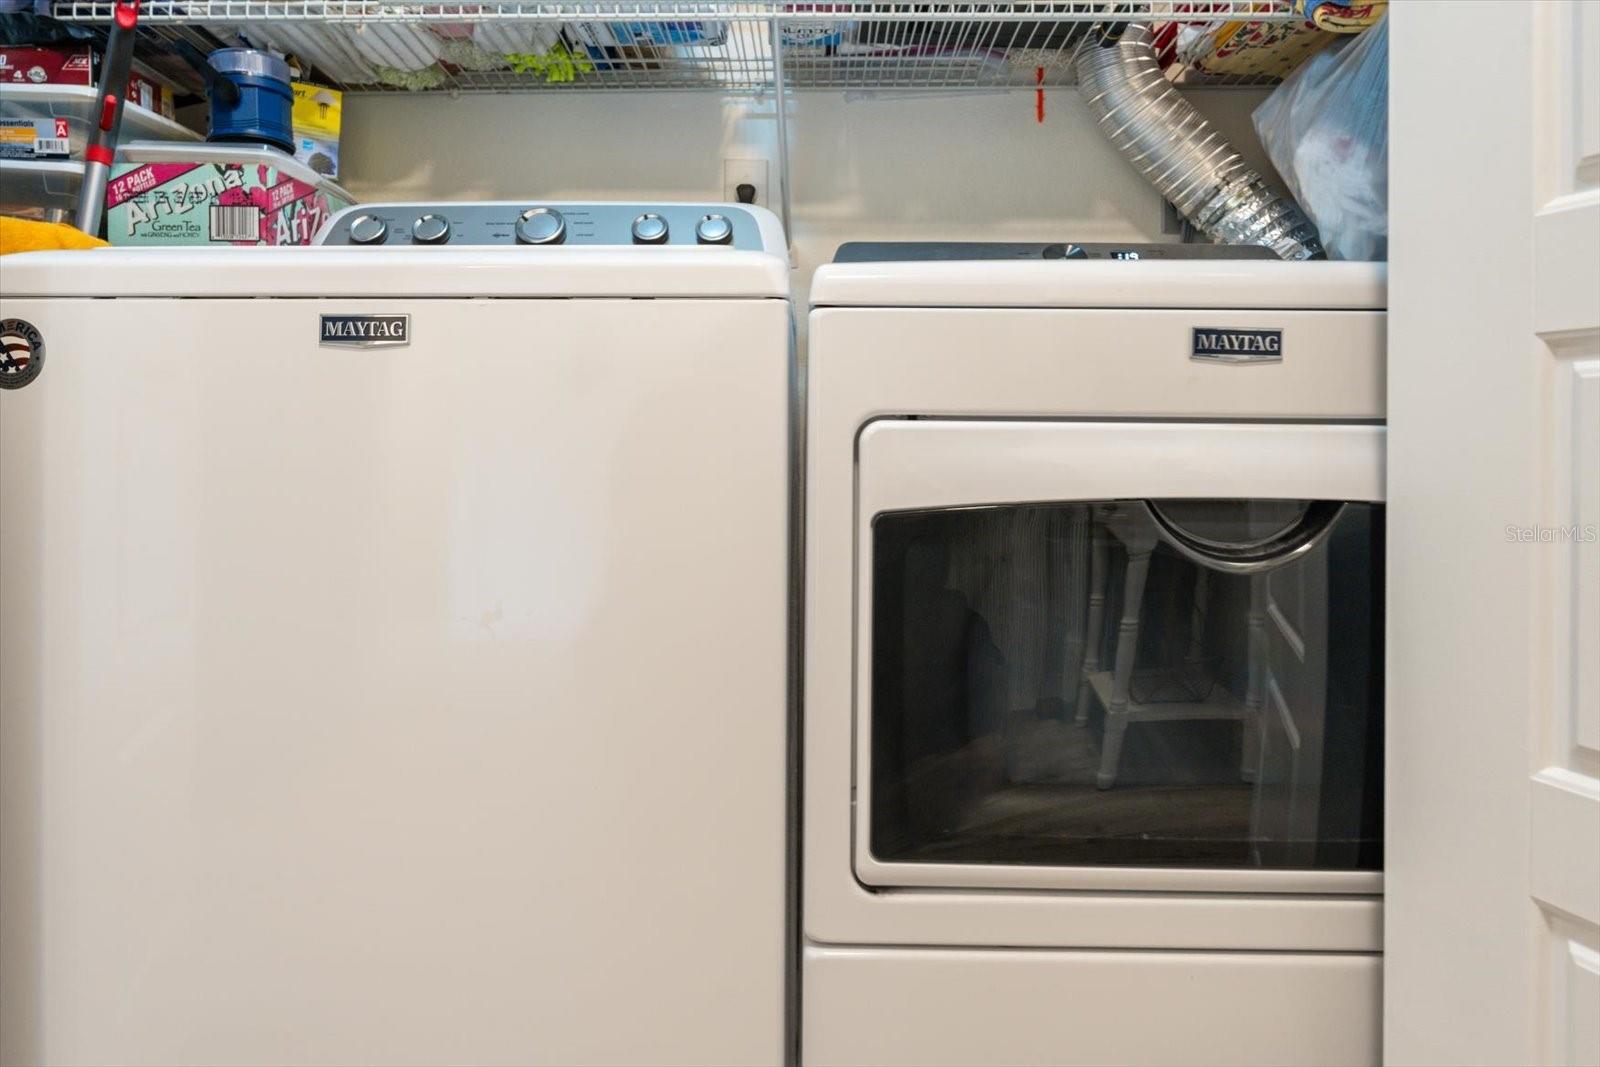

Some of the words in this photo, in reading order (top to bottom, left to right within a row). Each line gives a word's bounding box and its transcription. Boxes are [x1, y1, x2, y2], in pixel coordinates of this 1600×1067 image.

[0, 120, 34, 128] ssentials
[57, 124, 67, 136] A
[112, 181, 126, 195] 12
[126, 166, 155, 189] PACK
[152, 220, 183, 232] Green
[182, 220, 201, 232] Tea
[324, 321, 404, 337] MAYTAG
[1196, 333, 1279, 352] MAYTAG
